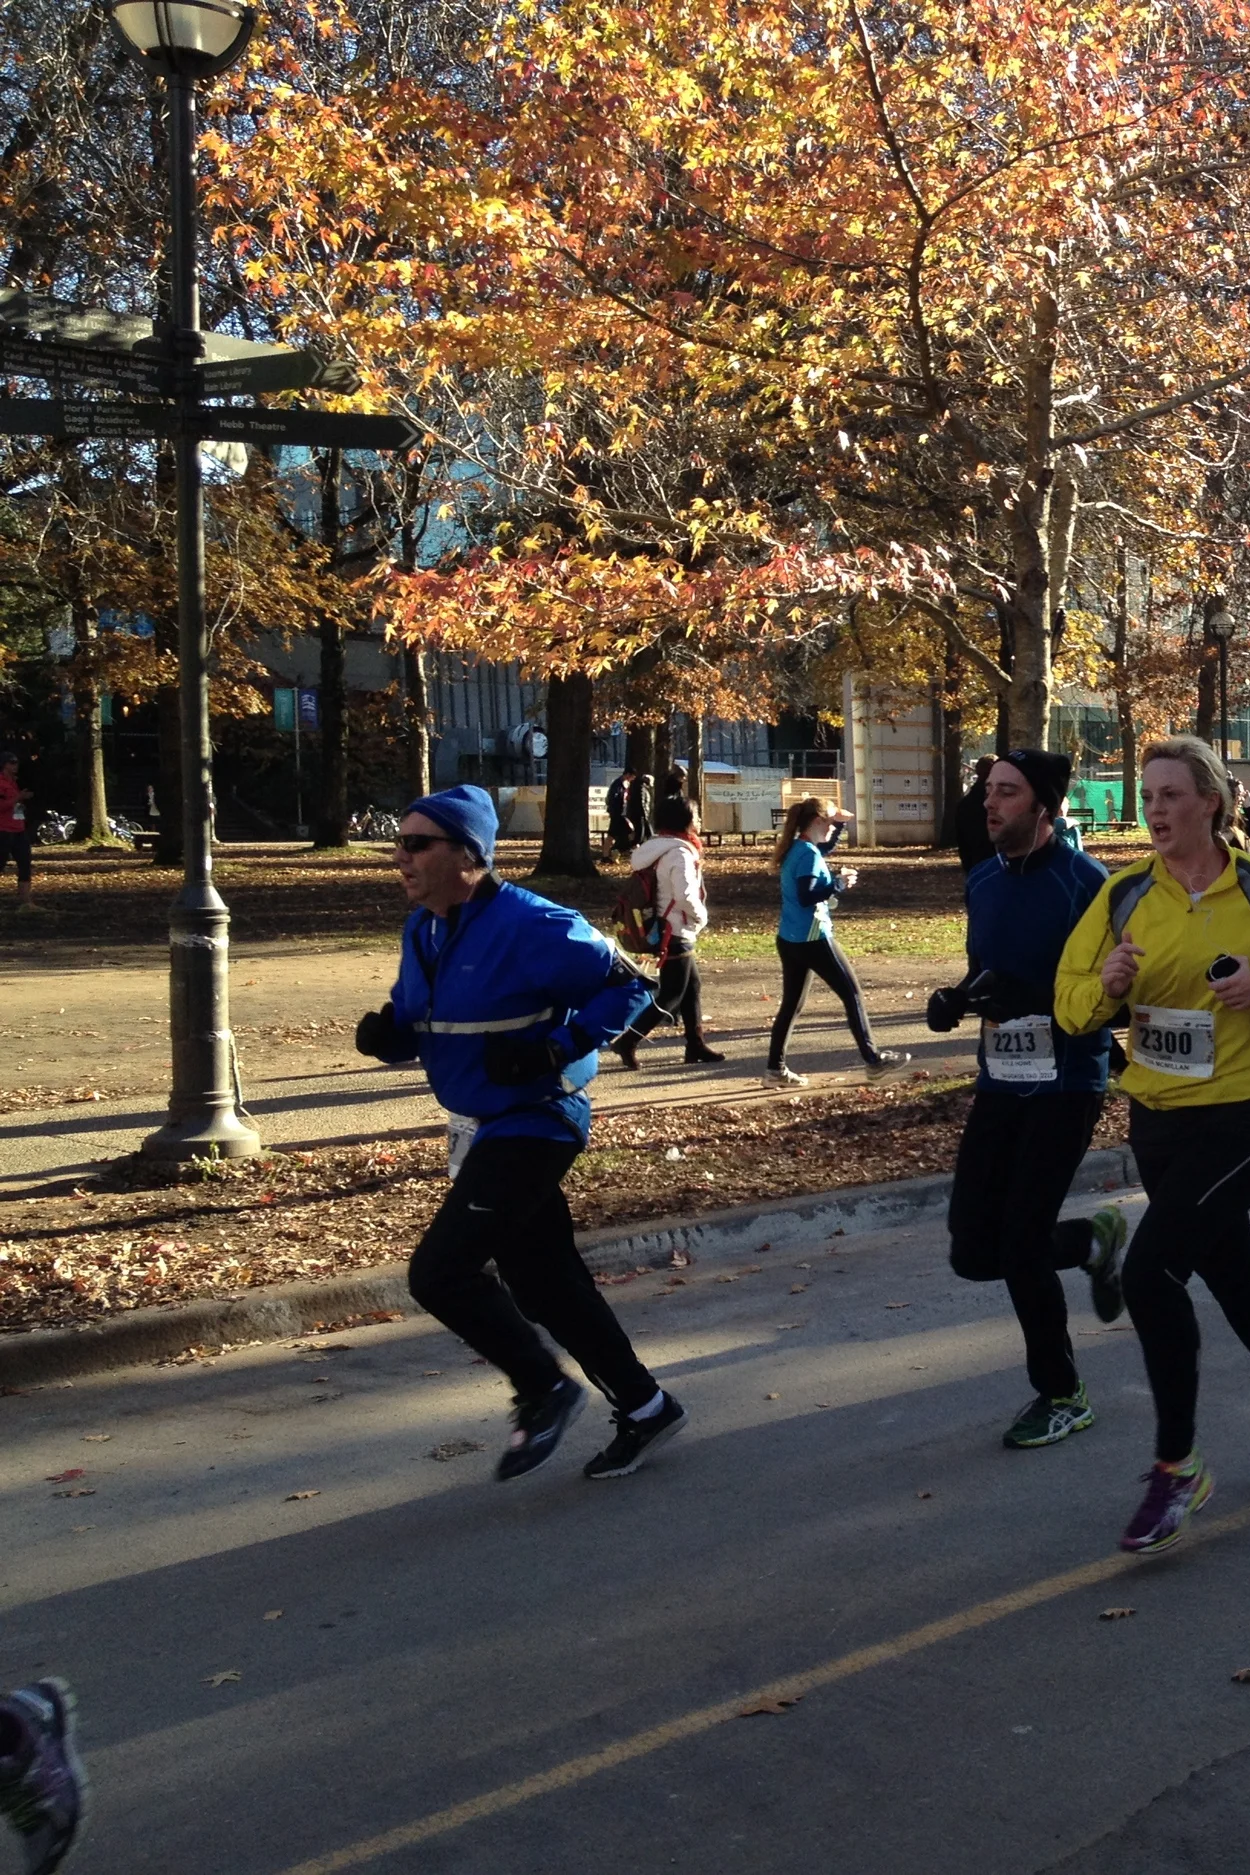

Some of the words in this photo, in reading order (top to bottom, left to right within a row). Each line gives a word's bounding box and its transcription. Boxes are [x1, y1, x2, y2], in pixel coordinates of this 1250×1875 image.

[28, 354, 55, 366] Green
[58, 358, 77, 370] Park
[87, 364, 113, 376] Green
[116, 367, 147, 382] College
[230, 367, 252, 377] Library
[4, 361, 42, 375] Museum
[45, 367, 55, 377] of
[60, 368, 120, 389] Anthropology
[220, 381, 242, 391] Library
[63, 404, 92, 413] North
[63, 414, 89, 425] Gage
[93, 415, 141, 425] Residence
[64, 425, 90, 434] West
[94, 425, 122, 435] Coast
[127, 426, 156, 436] Suites
[219, 420, 245, 429] Hebb
[249, 421, 286, 431] Theatre
[993, 1031, 1036, 1053] 2213
[1139, 1027, 1192, 1055] 2300
